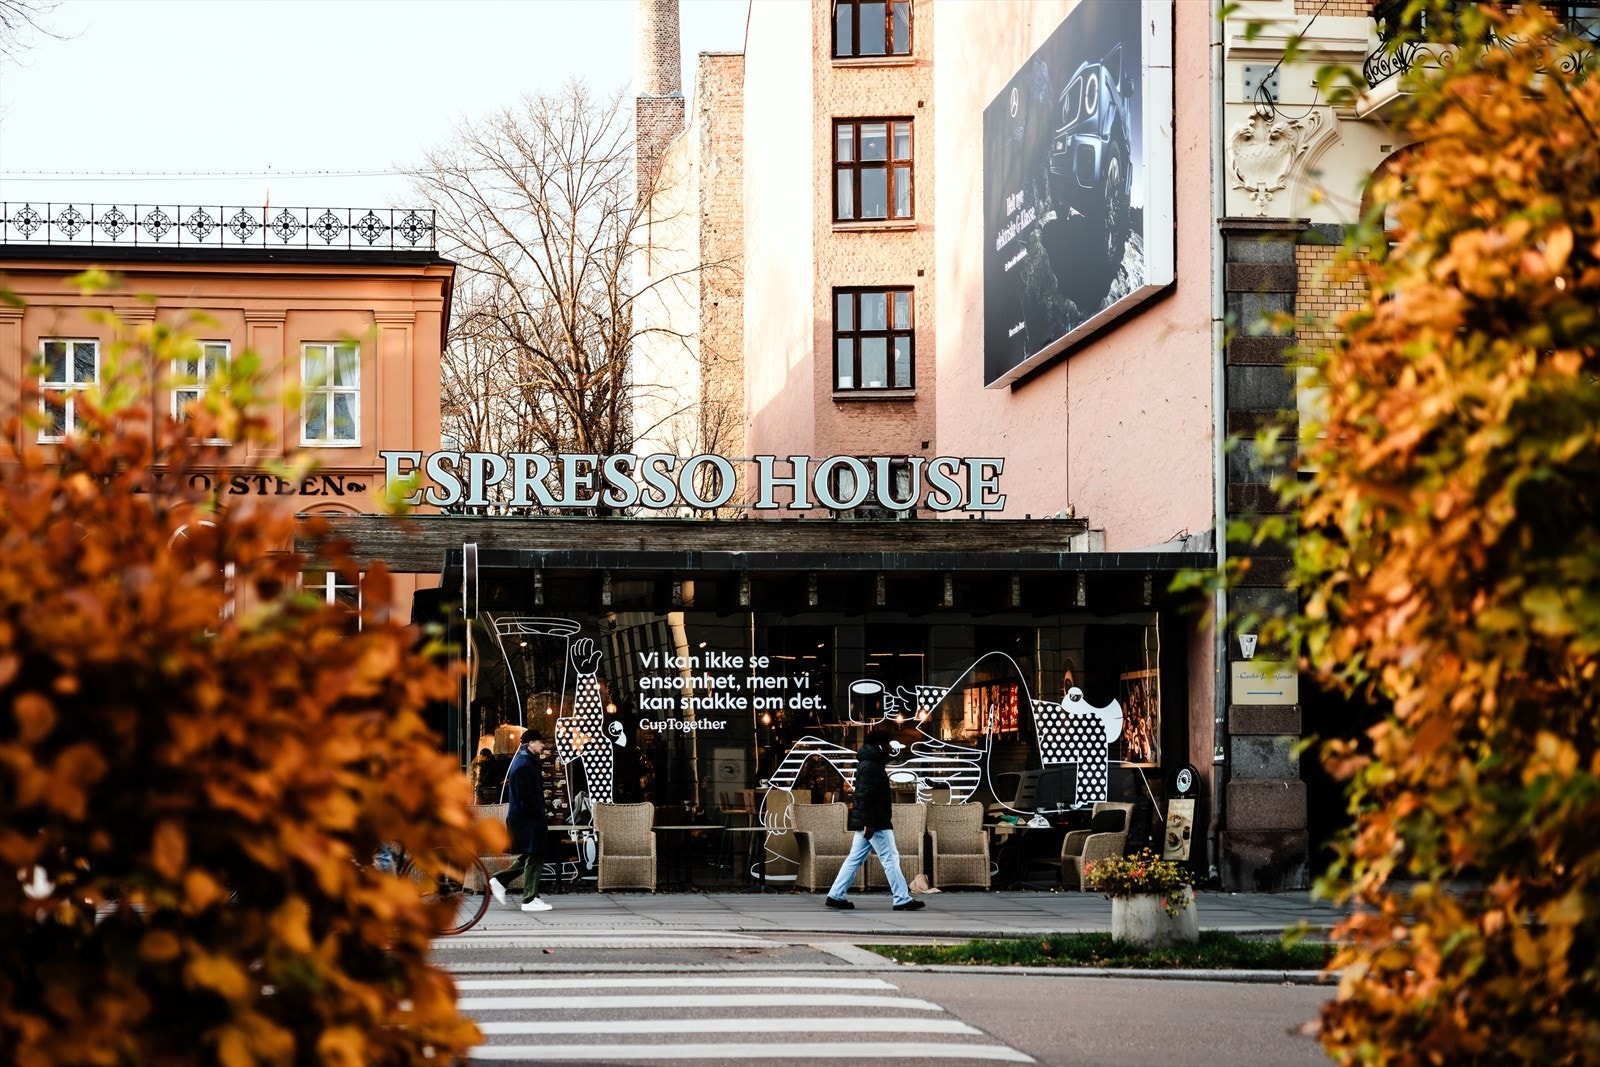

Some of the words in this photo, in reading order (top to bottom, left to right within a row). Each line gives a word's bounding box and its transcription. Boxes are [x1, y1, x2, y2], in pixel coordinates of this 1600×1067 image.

[228, 474, 346, 496] STEEN
[379, 450, 737, 509] ESPRESSO
[752, 454, 1007, 512] HOUSE
[639, 652, 659, 668] Vi
[664, 652, 699, 668] kan
[705, 652, 744, 668] ikke
[749, 656, 770, 668] se
[639, 672, 741, 691] ensomhet,
[746, 676, 788, 689] men
[793, 672, 810, 689] vi
[639, 692, 675, 709] kan
[680, 692, 748, 709] snakke
[752, 696, 784, 709] om
[788, 692, 827, 709] det.
[639, 718, 727, 733] CupTogether
